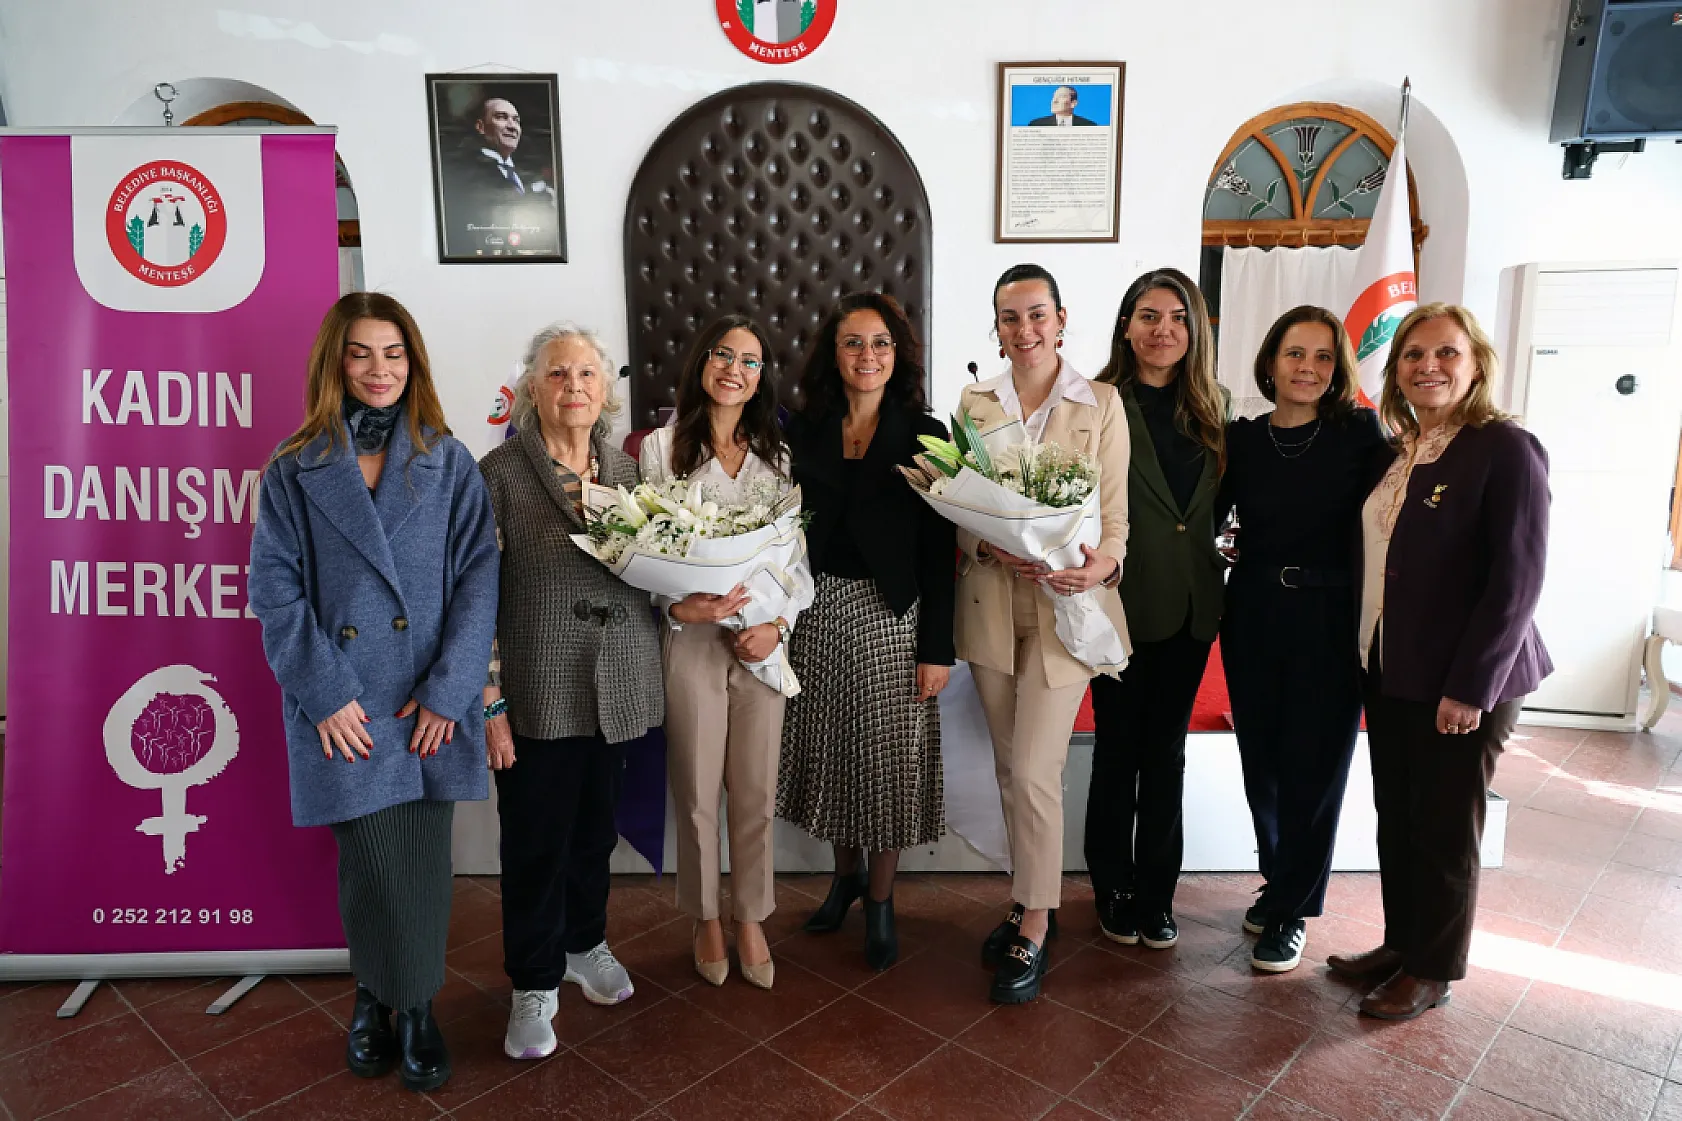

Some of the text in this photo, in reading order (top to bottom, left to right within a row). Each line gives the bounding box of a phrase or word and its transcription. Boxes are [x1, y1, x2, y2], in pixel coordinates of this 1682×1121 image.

[748, 41, 807, 58] MENTEŞE
[114, 167, 218, 214] BELEDİYE BAŞKANLIĞI
[139, 264, 195, 281] MENTEŞE
[82, 368, 253, 428] KADIN
[92, 908, 253, 924] 0 252 212 91 98
